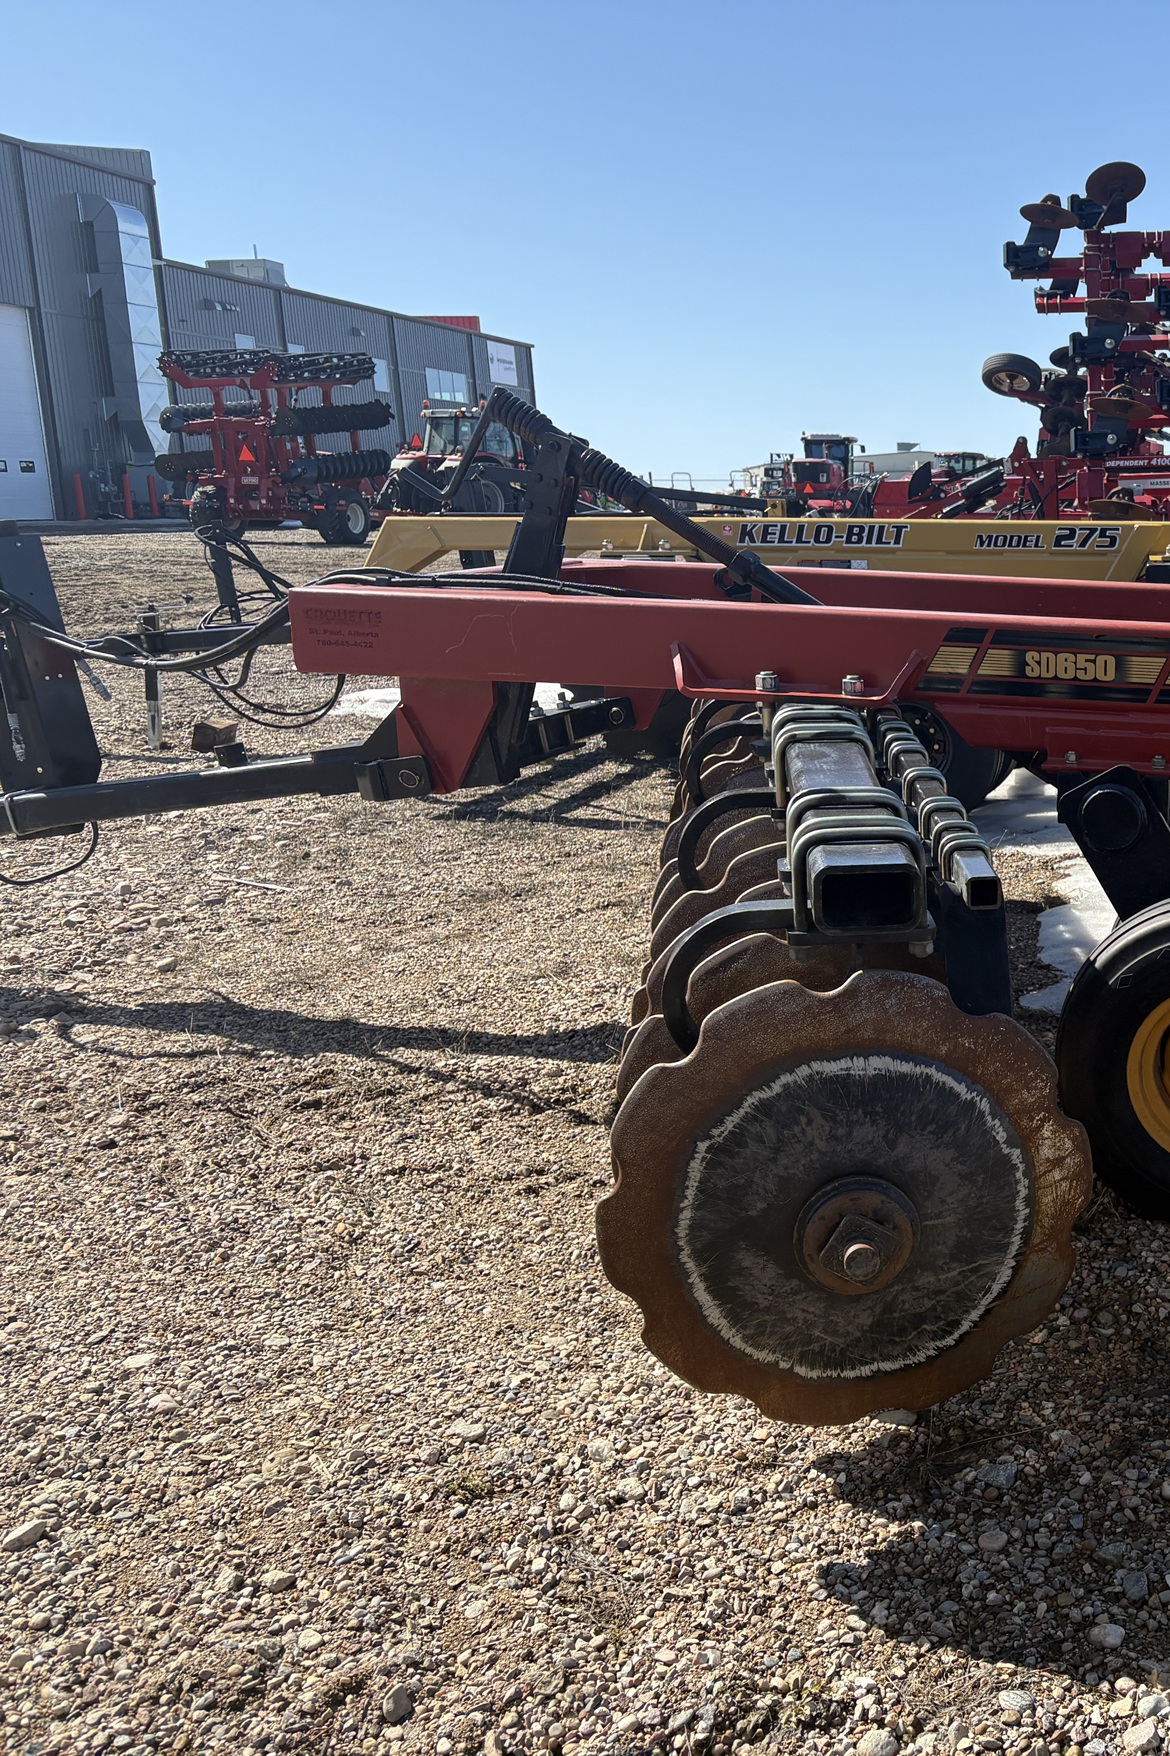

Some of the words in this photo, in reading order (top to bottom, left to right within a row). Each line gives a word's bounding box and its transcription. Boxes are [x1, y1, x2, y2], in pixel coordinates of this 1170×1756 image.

[737, 523, 910, 546] KELLO-BILT
[973, 533, 1046, 550] MODEL
[1052, 526, 1121, 550] 275
[347, 630, 379, 638] Alberta
[1025, 651, 1116, 682] SD650
